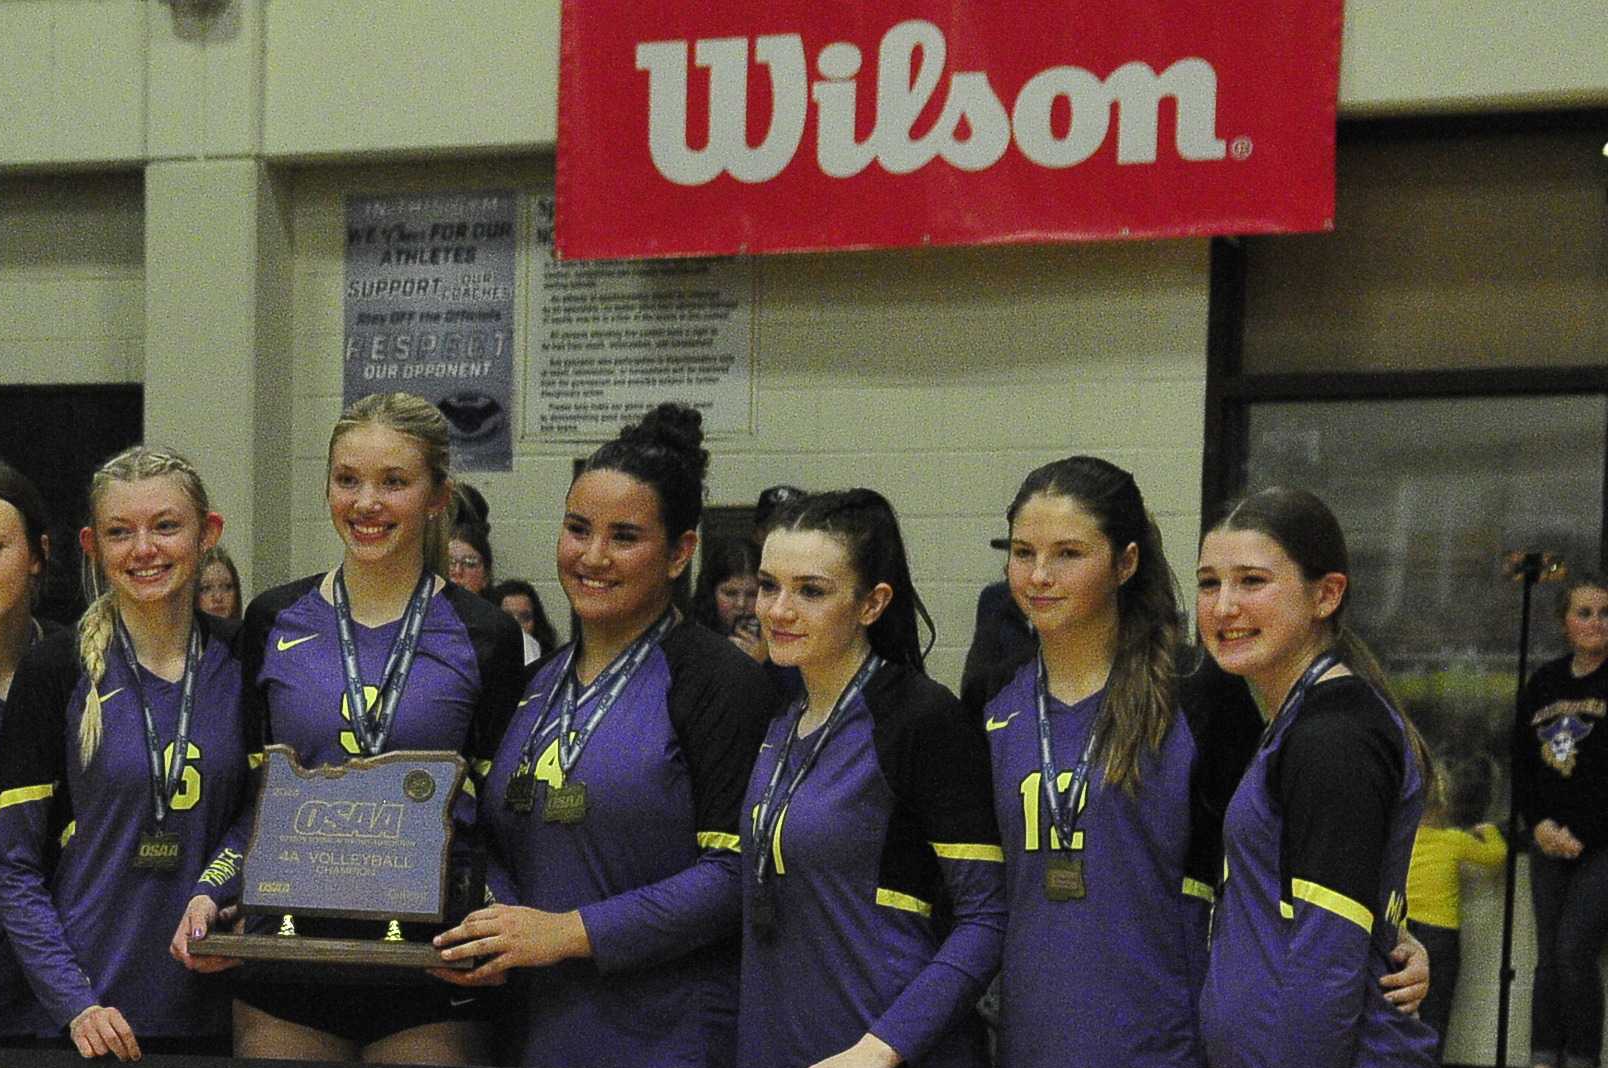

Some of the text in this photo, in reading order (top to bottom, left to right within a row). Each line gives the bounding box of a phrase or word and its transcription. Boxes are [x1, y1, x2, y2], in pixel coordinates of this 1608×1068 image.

[635, 18, 1228, 187] Wilson
[379, 247, 476, 266] ATHLETES
[348, 278, 442, 299] SUPPORT
[364, 361, 492, 380] OUR OPPONENT
[164, 742, 200, 809] 6
[294, 799, 404, 838] OSAA
[1020, 772, 1087, 849] 12
[139, 844, 178, 857] OSAA
[309, 851, 413, 869] VOLLEYBALL
